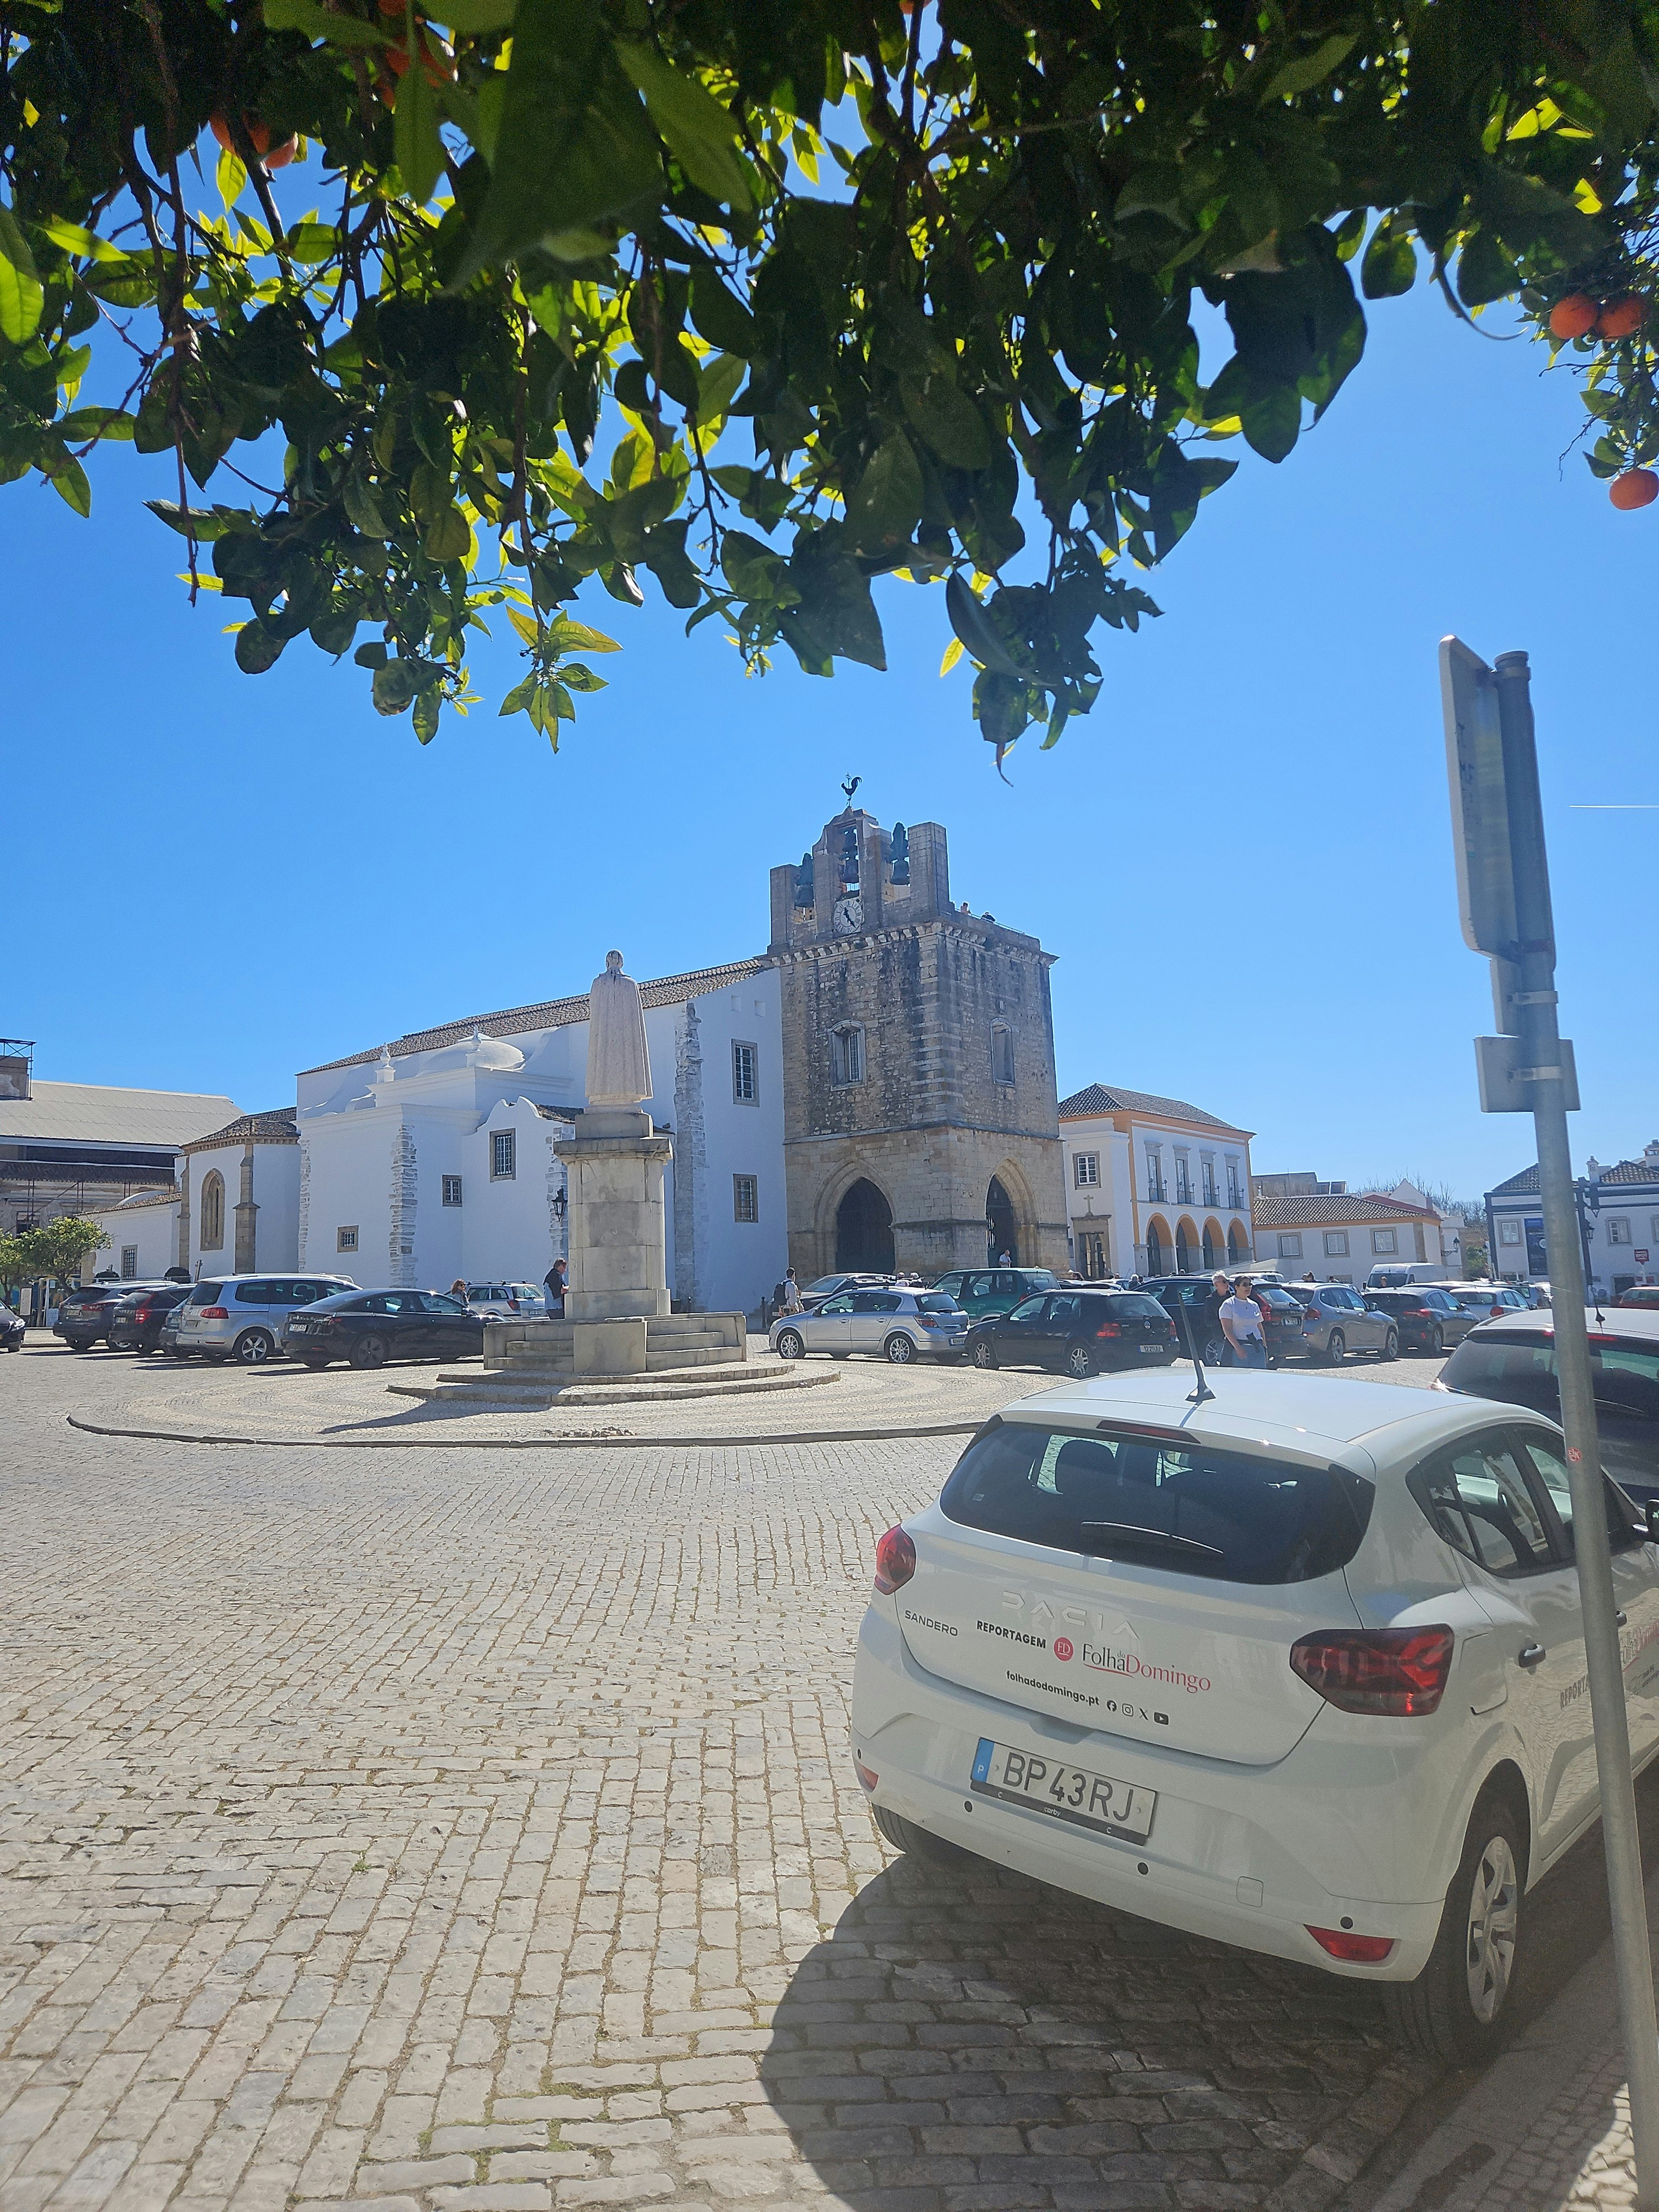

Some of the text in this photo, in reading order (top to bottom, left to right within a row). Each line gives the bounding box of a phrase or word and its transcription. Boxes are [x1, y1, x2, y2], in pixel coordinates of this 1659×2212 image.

[905, 1610, 958, 1636] SANDERO
[1002, 1590, 1140, 1639] DACIA
[976, 1620, 1071, 1654] REPORTAGEM FD
[1006, 1670, 1099, 1706] folhadodomingo.pt
[977, 1764, 984, 1773] P
